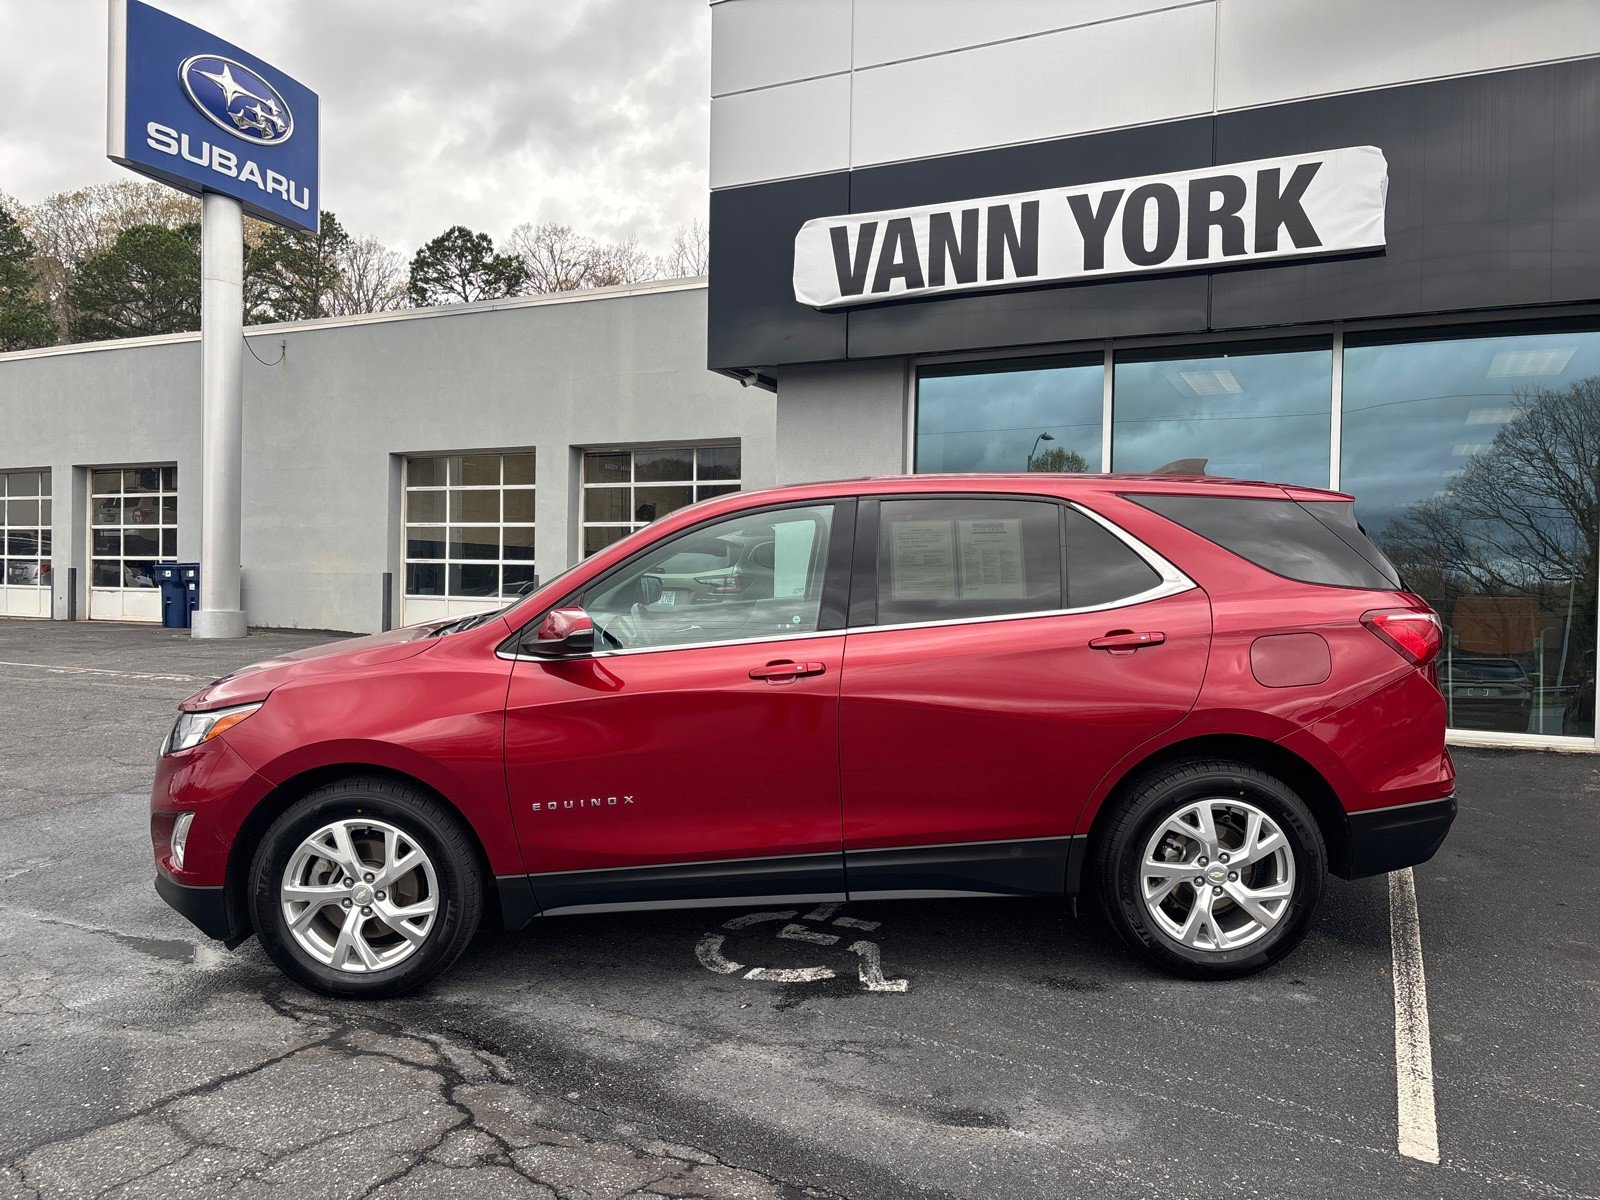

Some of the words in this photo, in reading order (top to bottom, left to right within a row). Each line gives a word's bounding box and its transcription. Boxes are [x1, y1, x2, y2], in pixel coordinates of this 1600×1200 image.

[146, 121, 309, 211] SUBARU
[829, 200, 1039, 297] VANN
[1067, 162, 1323, 271] YORK
[532, 795, 634, 811] EQUINOX
